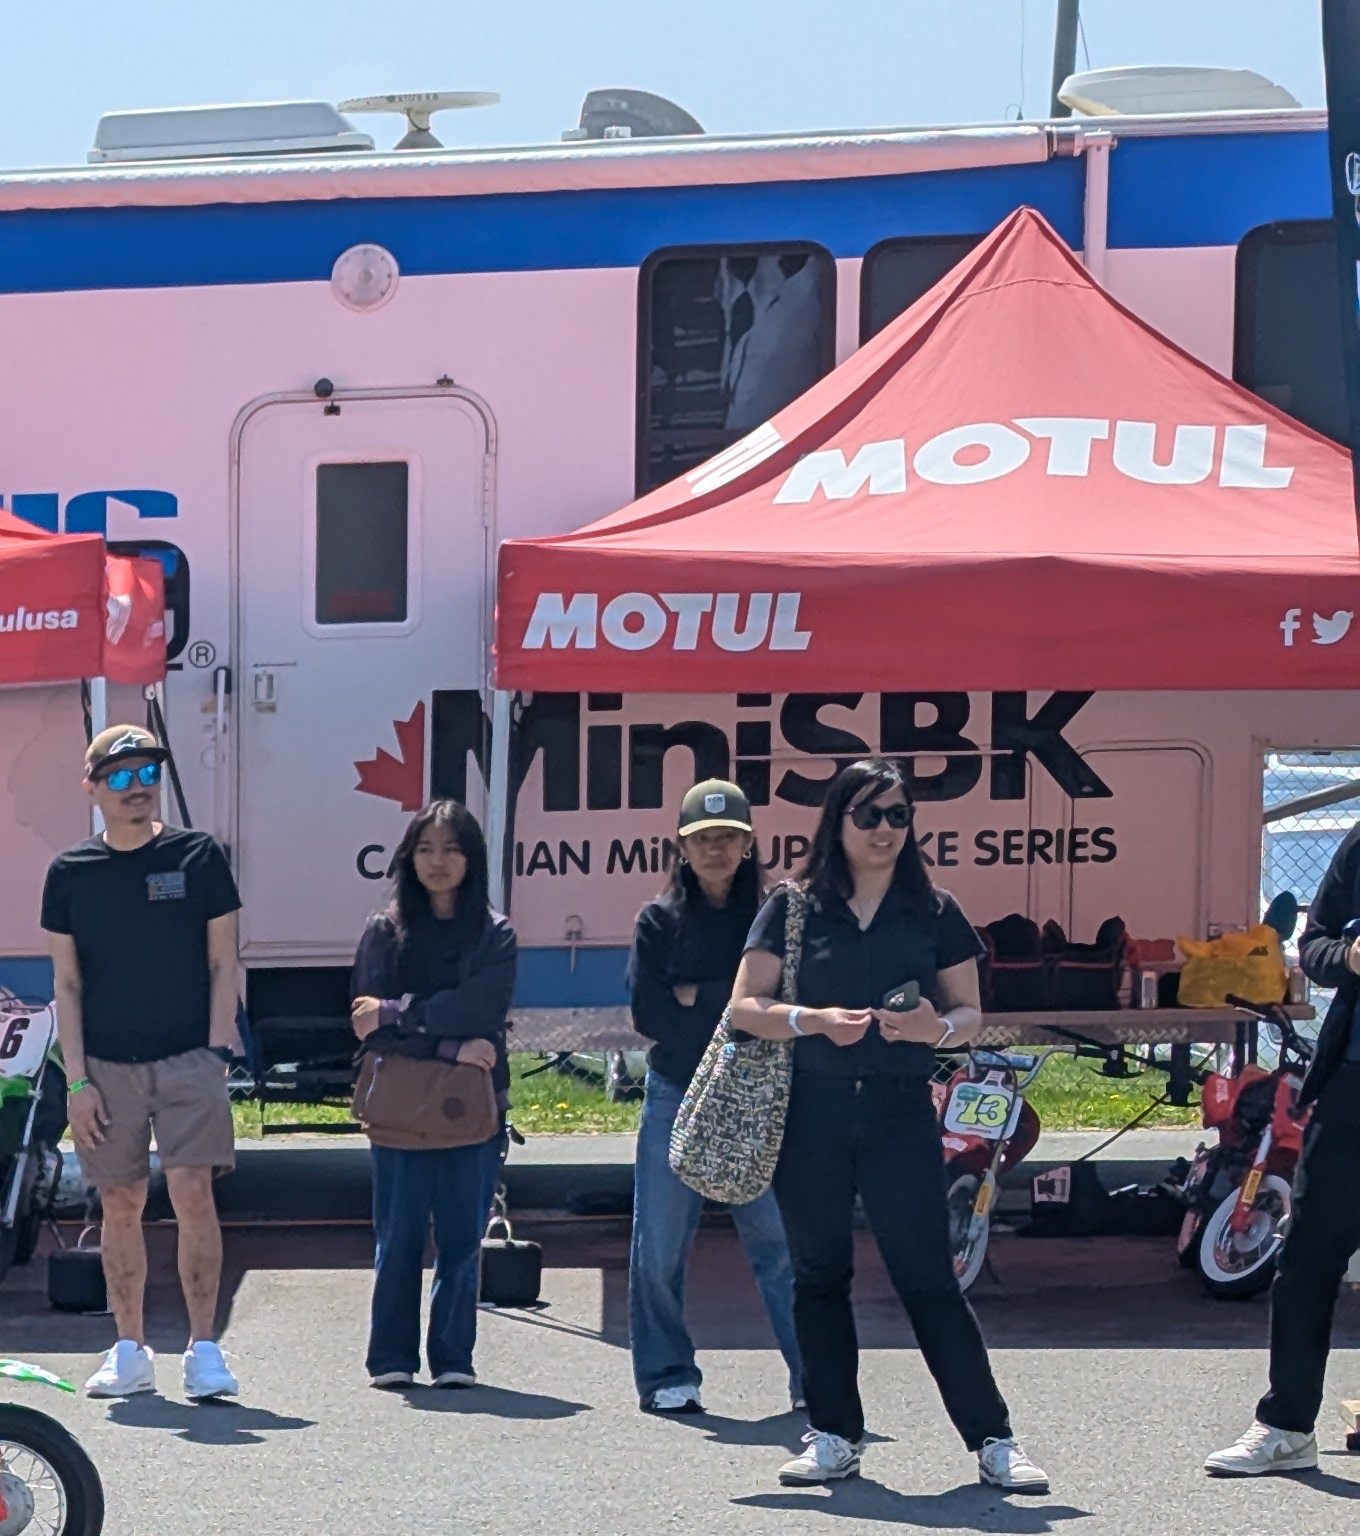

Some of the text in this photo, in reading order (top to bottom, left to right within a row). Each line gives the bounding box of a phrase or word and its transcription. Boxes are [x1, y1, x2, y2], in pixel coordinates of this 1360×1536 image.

[773, 417, 1295, 504] MOTUL
[522, 592, 813, 652] MOTUL
[974, 826, 1117, 866] SERIES
[955, 1093, 1010, 1128] 13
